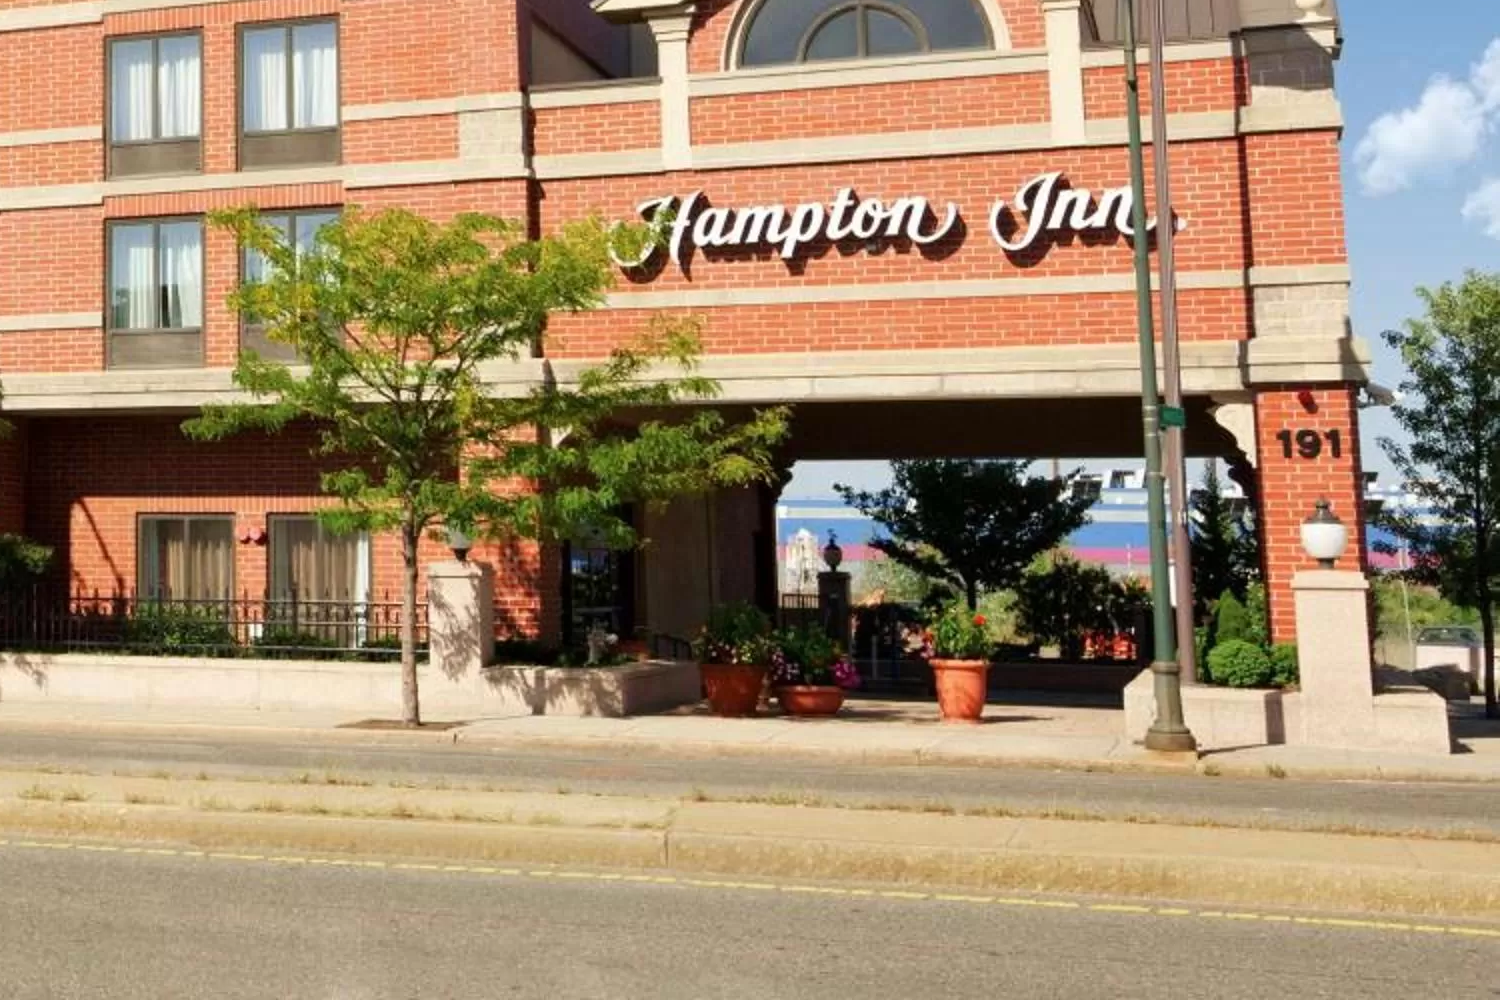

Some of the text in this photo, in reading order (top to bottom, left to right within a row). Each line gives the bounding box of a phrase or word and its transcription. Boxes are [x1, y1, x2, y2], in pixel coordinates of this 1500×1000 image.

[606, 171, 1164, 267] Hampton Inn
[1276, 428, 1341, 459] 191
